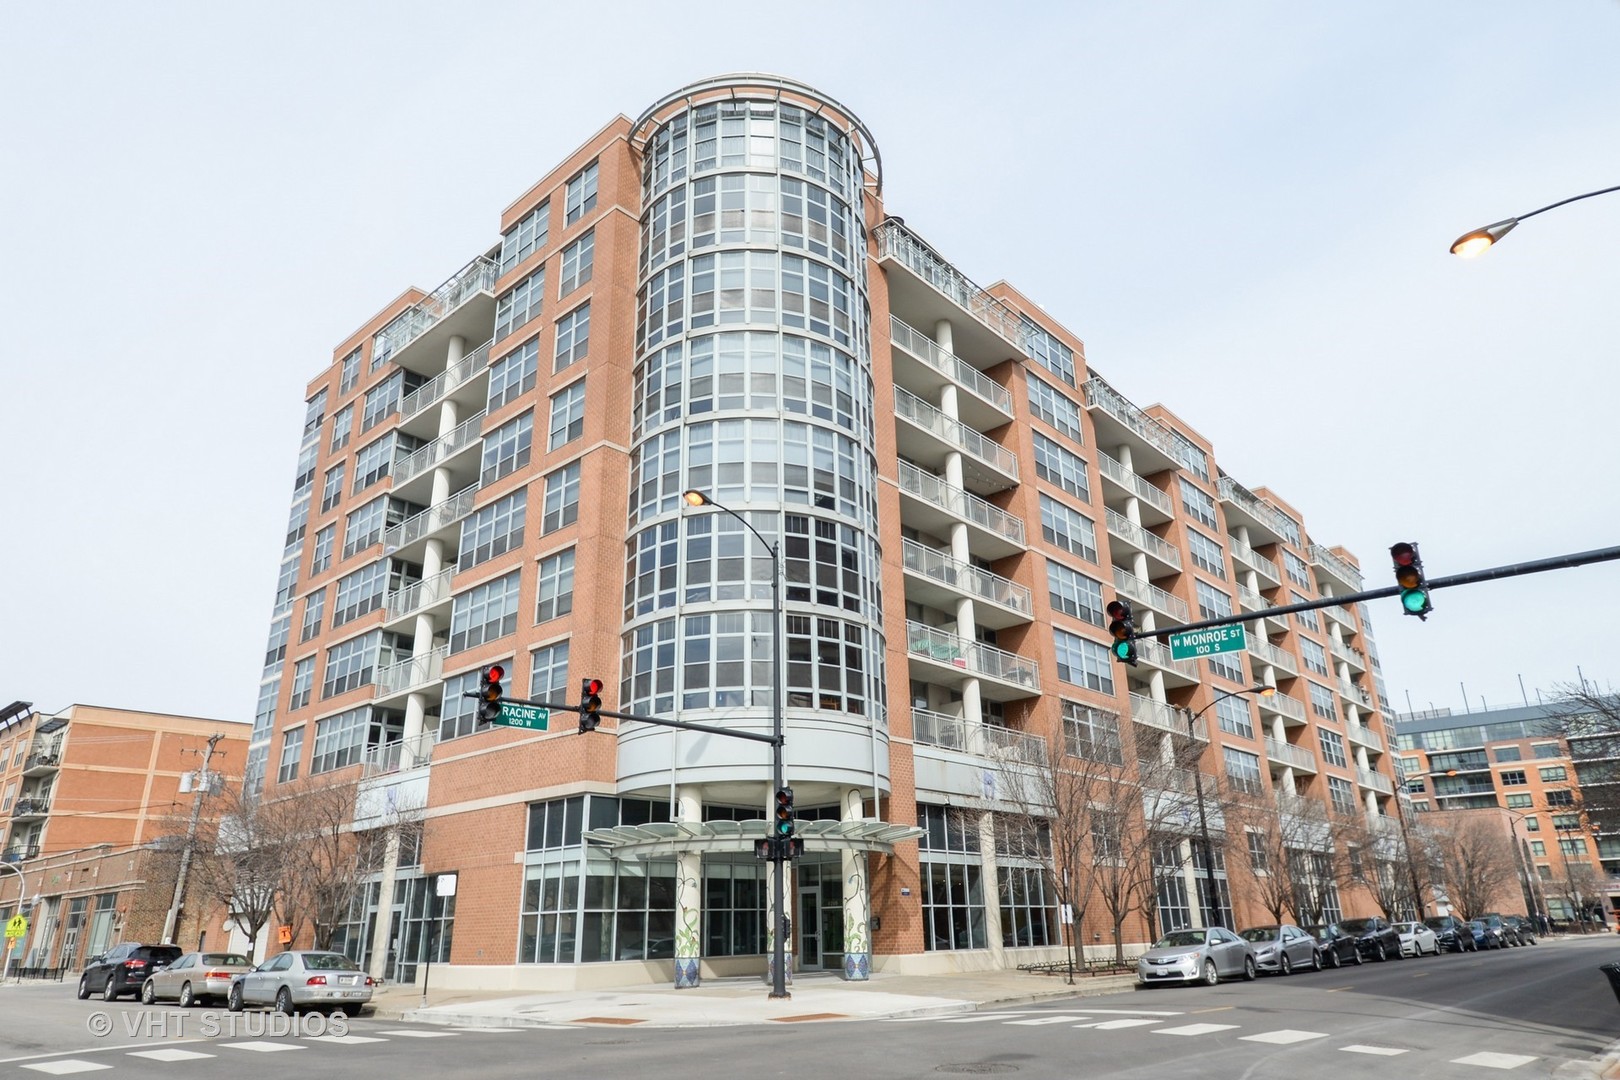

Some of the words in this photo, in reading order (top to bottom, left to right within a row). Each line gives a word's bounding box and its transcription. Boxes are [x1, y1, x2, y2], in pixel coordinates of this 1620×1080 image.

[1183, 630, 1229, 647] MONROE
[1230, 629, 1241, 637] ST
[1196, 645, 1210, 654] 100
[1214, 643, 1220, 651] S
[502, 706, 537, 720] RACINE
[508, 717, 523, 726] 1200
